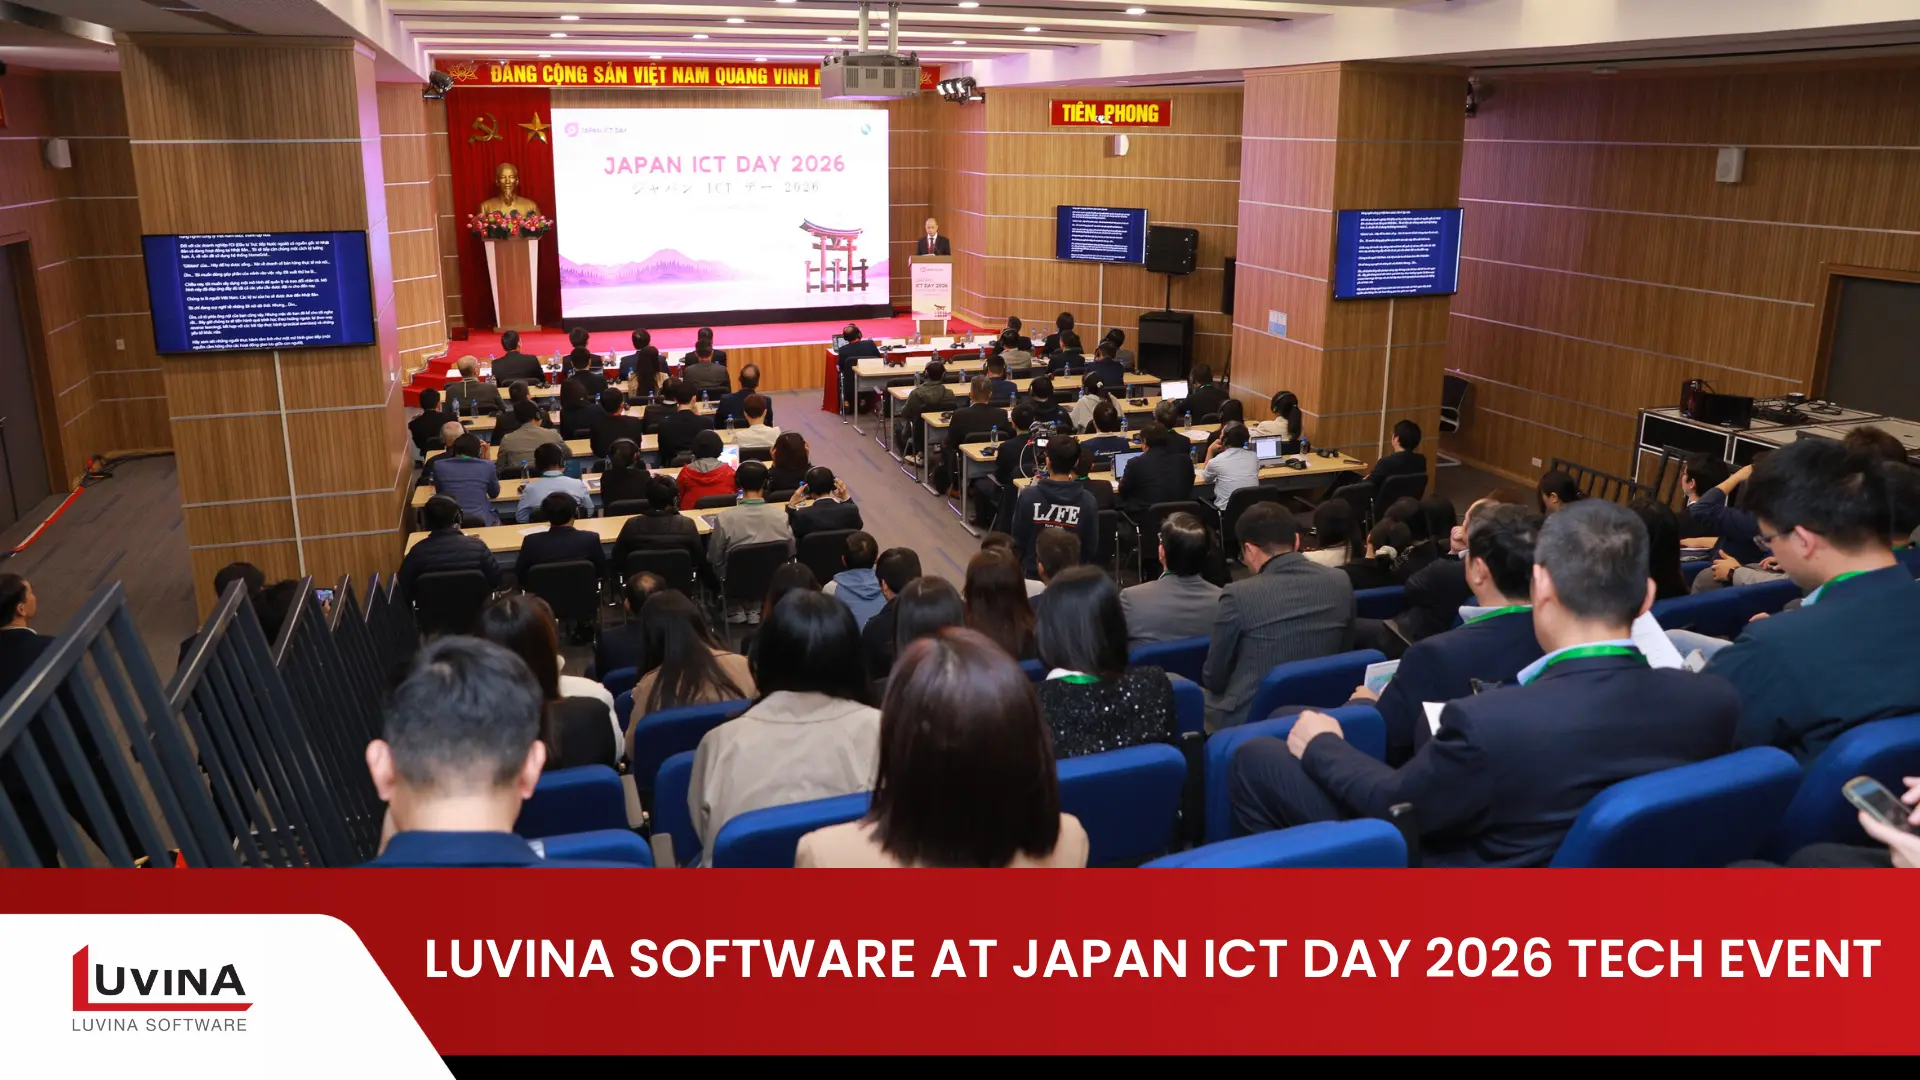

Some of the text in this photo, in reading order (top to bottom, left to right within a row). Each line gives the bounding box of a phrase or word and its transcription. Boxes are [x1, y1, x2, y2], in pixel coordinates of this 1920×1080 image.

[491, 60, 537, 83] ĐẢNG
[543, 63, 588, 86] CỘNG
[594, 61, 627, 84] SẢN
[633, 63, 667, 86] VIỆT
[672, 66, 710, 84] NAM
[715, 67, 768, 86] QUANG
[773, 68, 809, 85] VINH
[1104, 103, 1159, 123] PHONG
[604, 154, 846, 175] JAPAN ICT DAY 2026
[784, 181, 820, 193] 2026
[1033, 502, 1081, 525] LIFE
